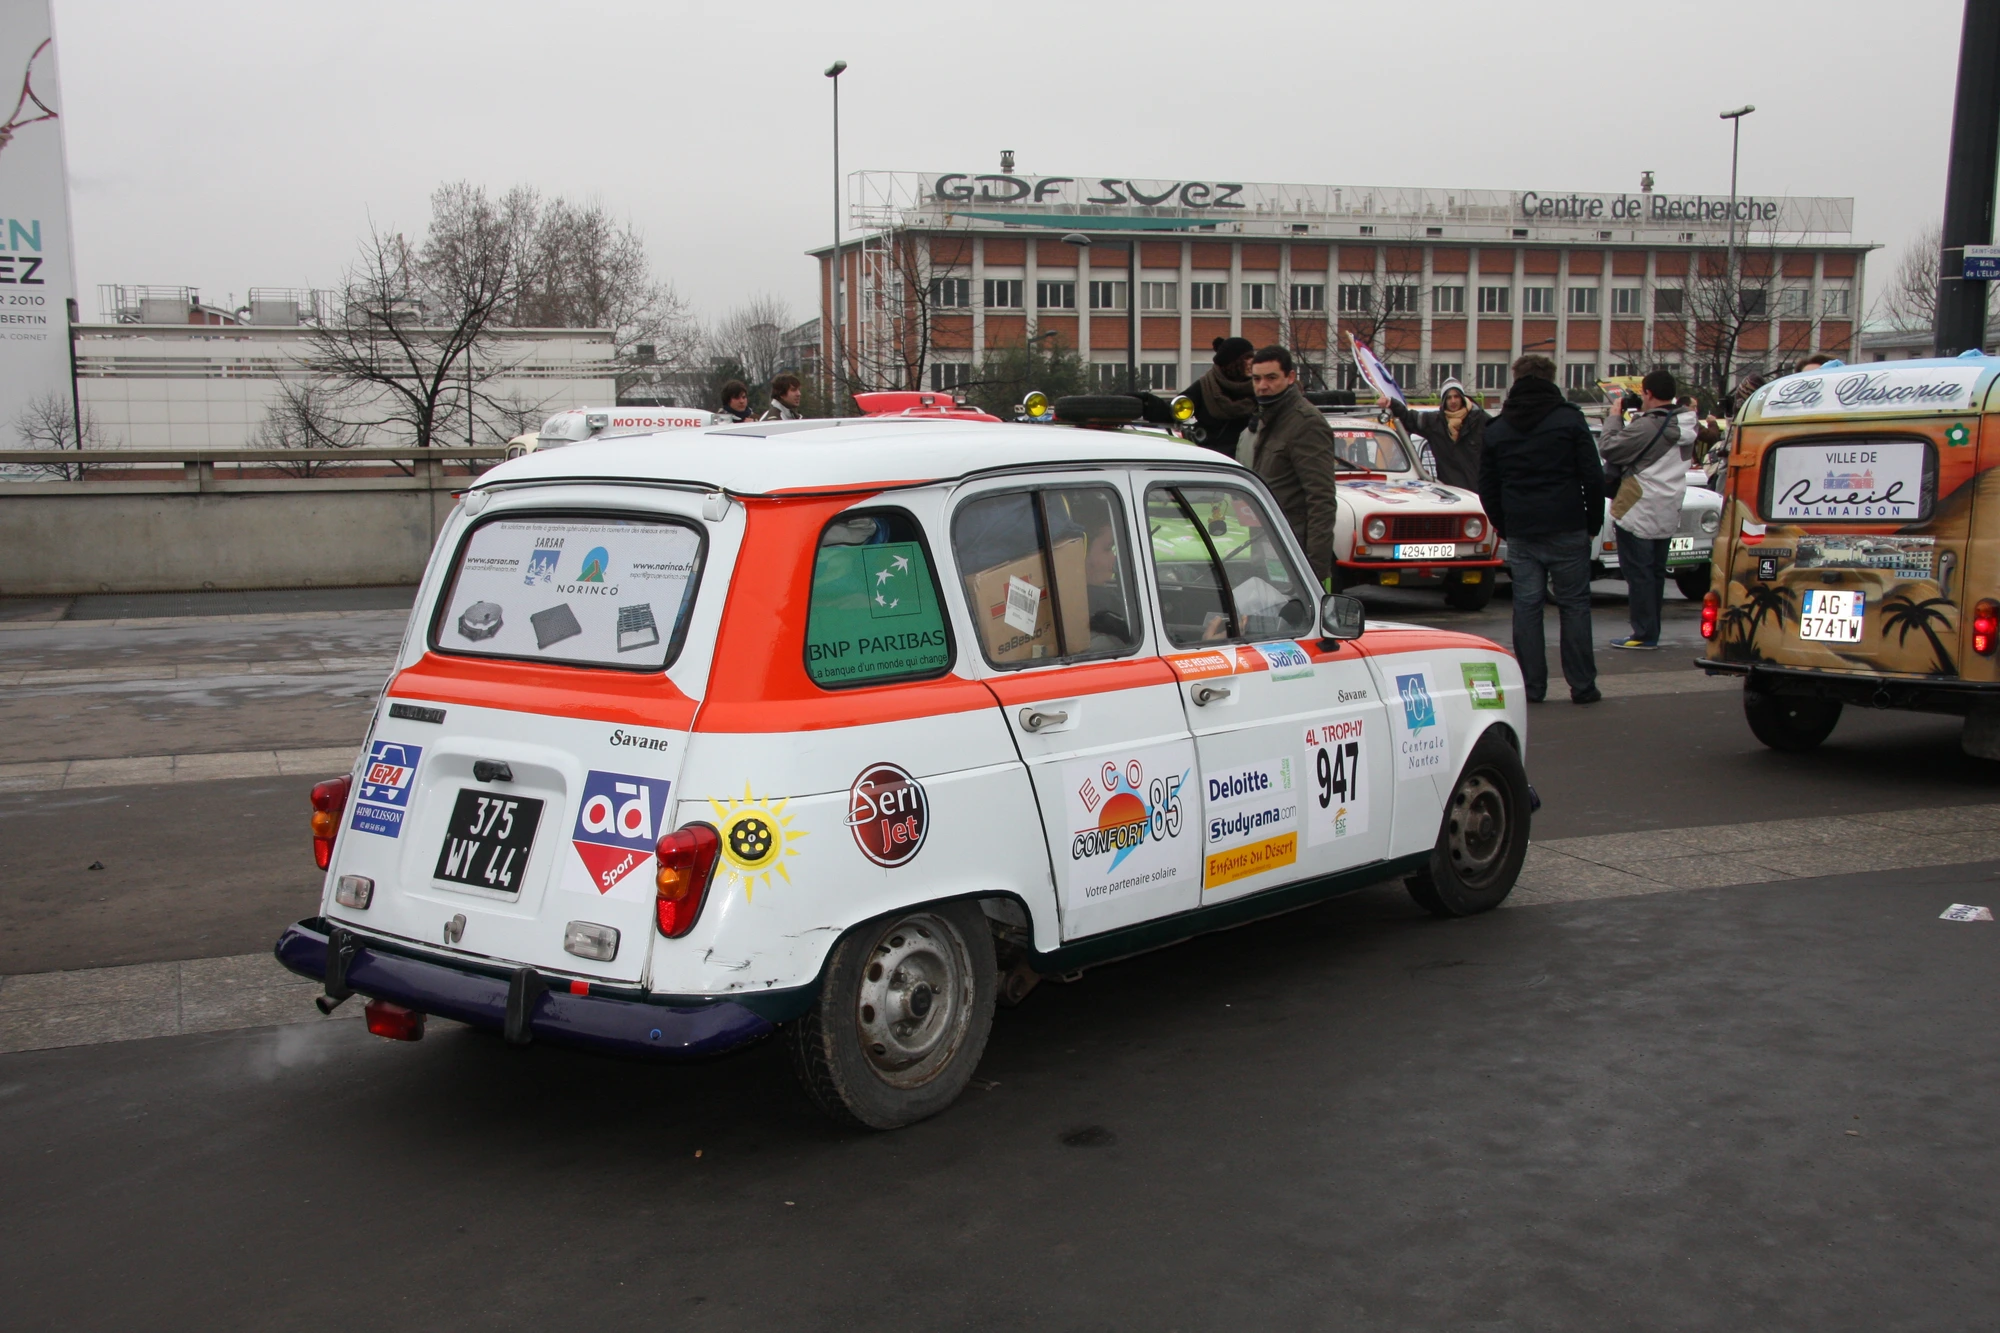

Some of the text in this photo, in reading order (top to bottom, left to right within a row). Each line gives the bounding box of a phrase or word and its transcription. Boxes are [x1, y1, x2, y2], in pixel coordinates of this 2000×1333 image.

[935, 173, 1074, 203] GDF
[1521, 191, 1604, 217] Centre
[1611, 194, 1641, 218] de
[0, 218, 42, 252] N
[10, 295, 45, 306] 2010
[0, 314, 46, 324] BERTIN
[10, 333, 47, 341] CORNET
[1769, 371, 1963, 407] La Vasconia
[613, 418, 702, 428] MOTO-STORE
[1825, 452, 1877, 463] VILLE DE
[1778, 478, 1916, 506] Rueil
[1788, 506, 1901, 517] MALMAISON
[535, 537, 565, 548] SARSAR
[1401, 545, 1453, 558] 4294 YP 02
[467, 557, 519, 566] www.sarsar.ma
[1762, 561, 1773, 570] 4L
[556, 584, 619, 596] NORINCO
[808, 629, 945, 661] BNP PARIBAS
[825, 664, 856, 677] banque
[857, 662, 875, 673] d'un
[877, 658, 903, 670] monde
[906, 657, 918, 670] qui
[919, 653, 948, 665] change
[1175, 655, 1224, 668] ESC RENNES
[1338, 689, 1368, 702] Savane
[610, 729, 668, 752] Savane
[1305, 719, 1363, 746] 4L TROPHY
[1402, 736, 1444, 754] Centrale
[1408, 755, 1439, 769] Nantes
[1078, 759, 1143, 813] ECO
[1316, 741, 1359, 809] 947
[843, 779, 918, 826] Seri
[356, 806, 402, 823] 44190 CLISSON
[469, 797, 518, 839] 375
[1072, 774, 1183, 860] CONFORT 85
[1210, 805, 1297, 840] Studyrama.com
[1335, 818, 1346, 830] ESC
[880, 815, 920, 853] Jet
[445, 838, 517, 887] WY 44
[602, 853, 634, 886] Sport
[1209, 855, 1248, 877] Enfants
[1085, 866, 1177, 898] Votre partenaire solaire
